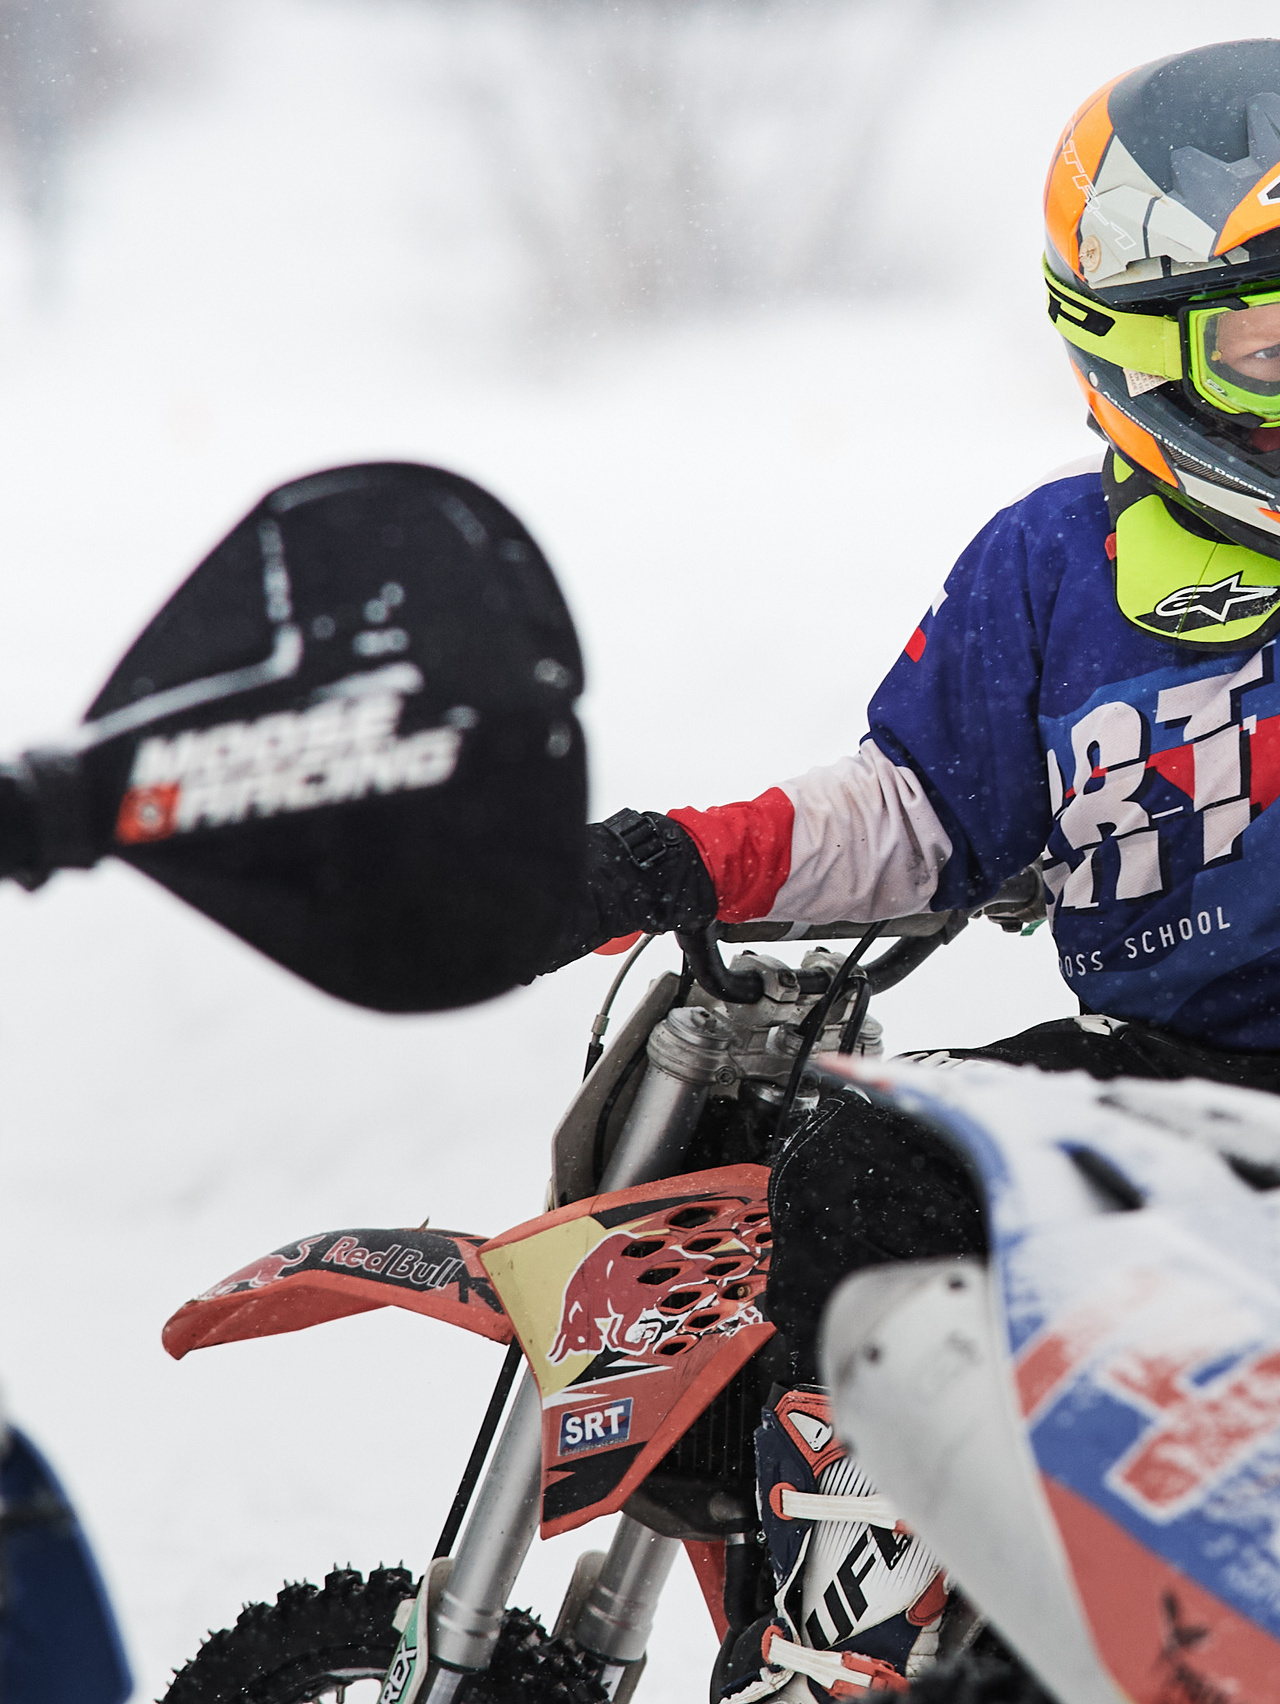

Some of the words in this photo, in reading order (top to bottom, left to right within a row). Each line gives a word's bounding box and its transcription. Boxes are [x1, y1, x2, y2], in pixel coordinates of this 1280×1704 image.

[1163, 437, 1213, 469] Impact
[1214, 466, 1276, 499] Defense
[129, 688, 403, 788] MOOSE
[172, 724, 462, 834] RACING
[1042, 640, 1277, 920] RT
[1124, 906, 1231, 960] SCHOOL
[565, 1405, 625, 1446] SRT
